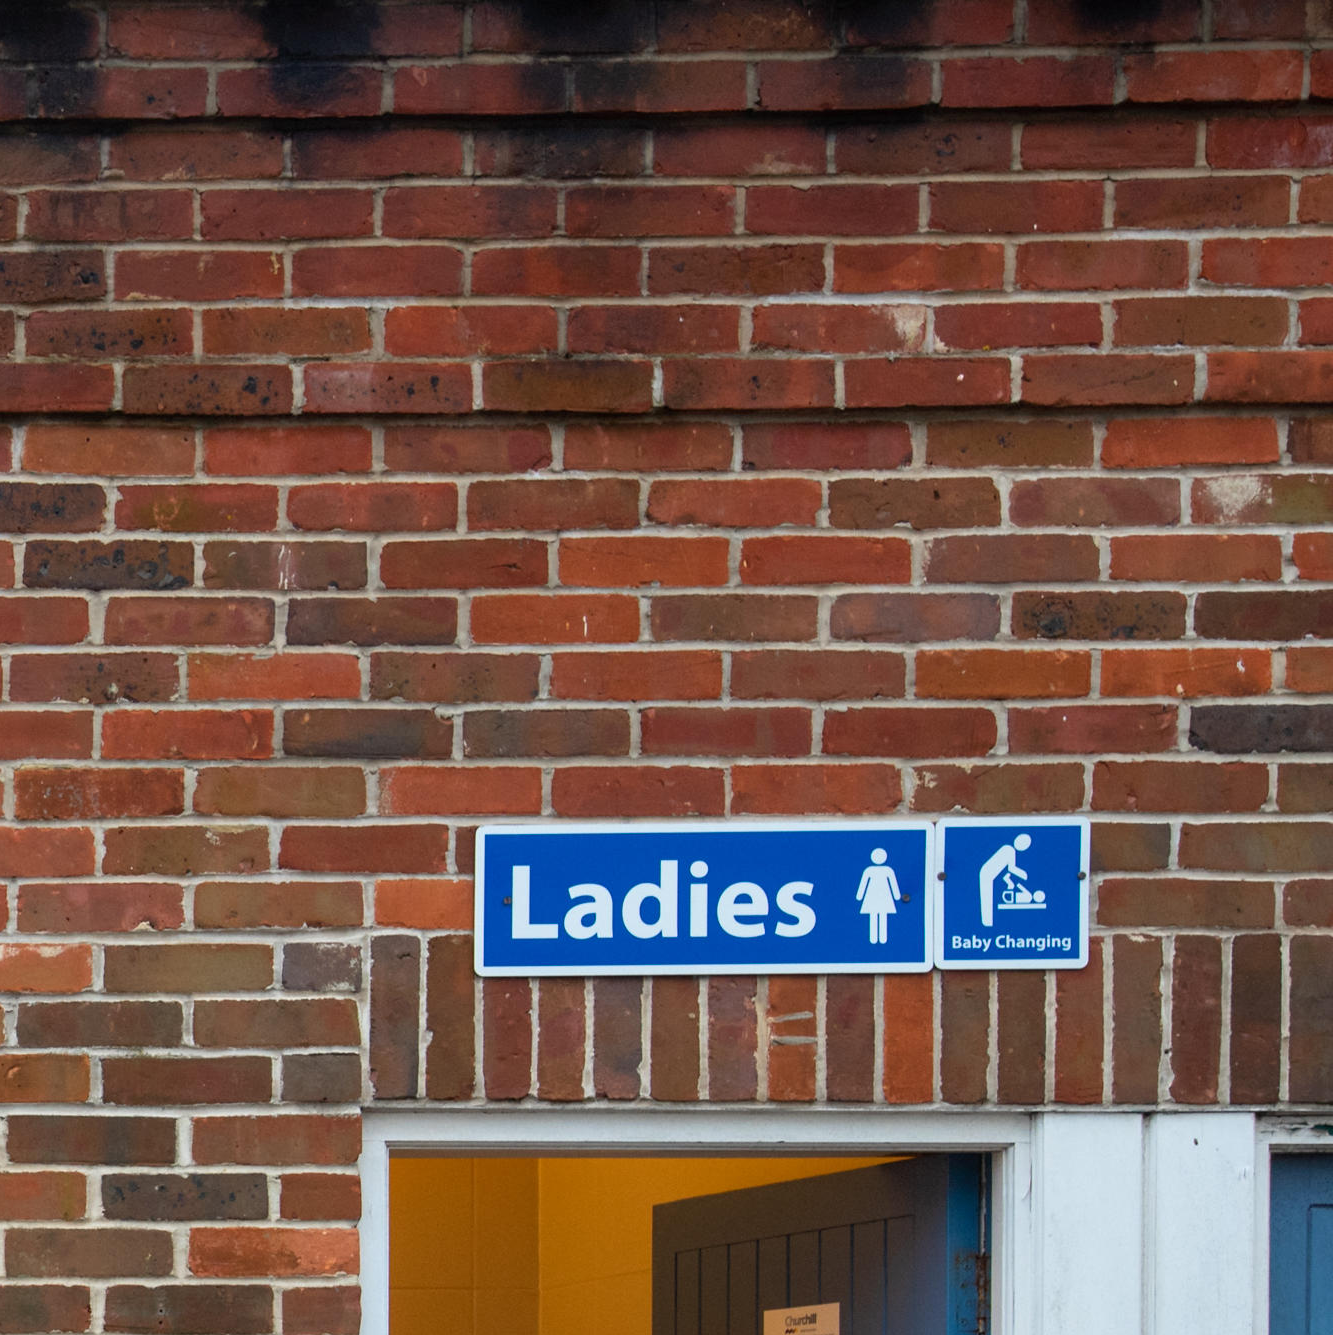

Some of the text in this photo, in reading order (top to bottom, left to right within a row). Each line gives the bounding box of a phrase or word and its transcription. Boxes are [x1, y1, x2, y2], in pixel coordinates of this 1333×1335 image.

[511, 859, 817, 940] Ladies
[951, 934, 1072, 952] Baby Changing
[785, 1313, 817, 1327] Churchill
